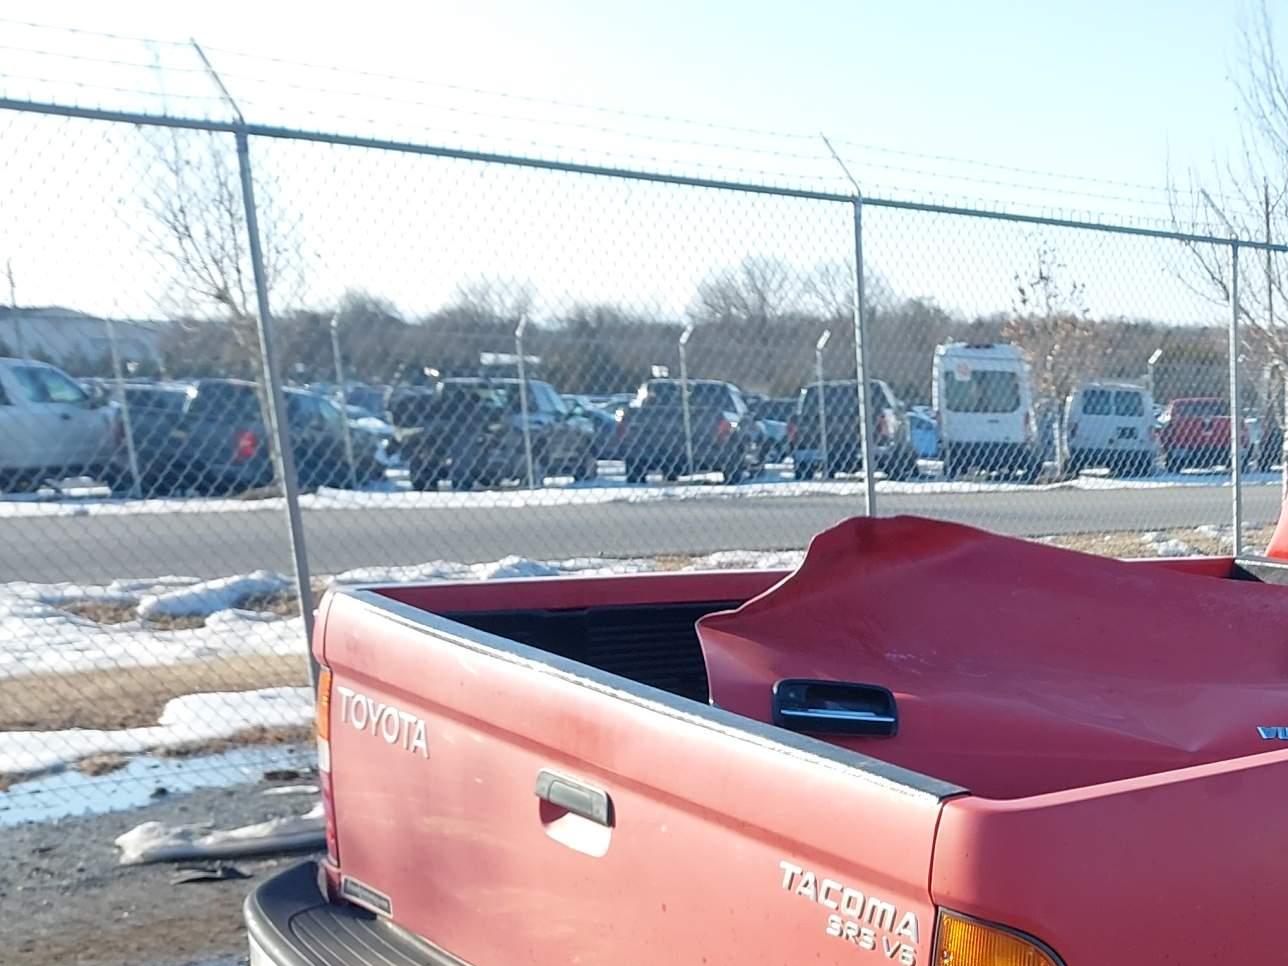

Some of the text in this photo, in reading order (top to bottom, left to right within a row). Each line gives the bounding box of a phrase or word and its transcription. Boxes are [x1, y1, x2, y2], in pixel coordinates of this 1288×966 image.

[336, 686, 430, 759] TOYOTA
[779, 860, 919, 943] TACOMA
[882, 936, 918, 966] V6
